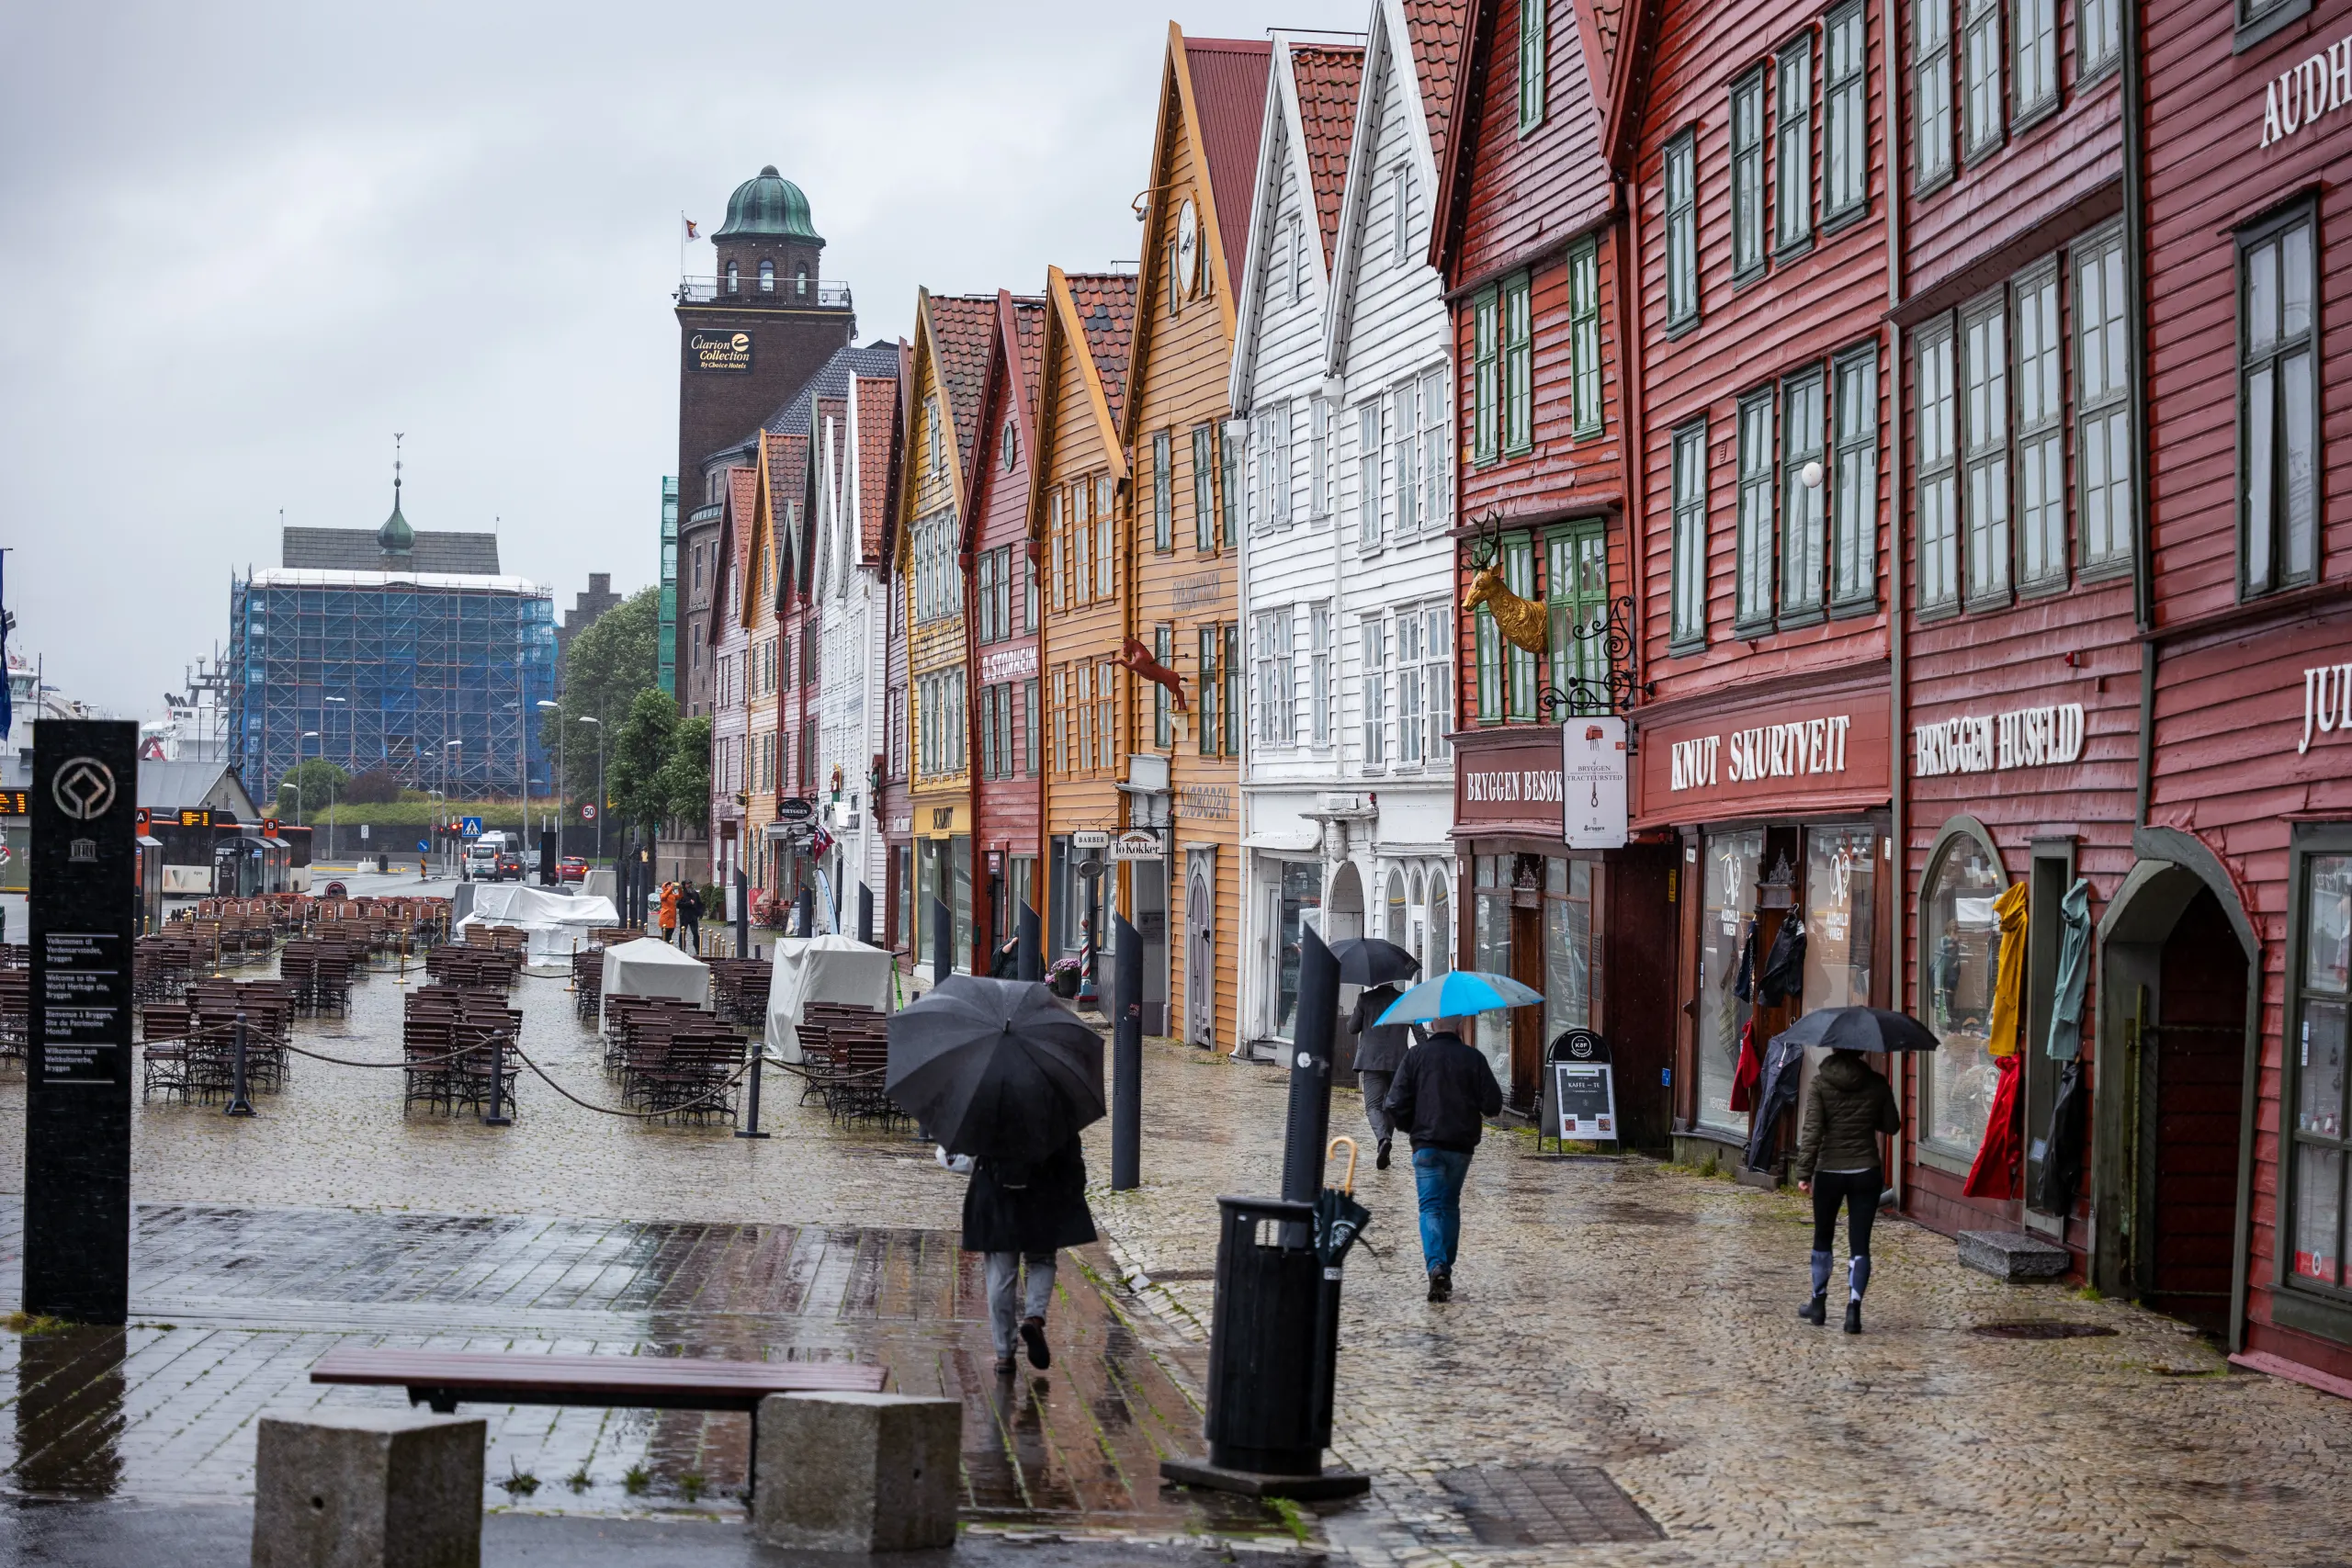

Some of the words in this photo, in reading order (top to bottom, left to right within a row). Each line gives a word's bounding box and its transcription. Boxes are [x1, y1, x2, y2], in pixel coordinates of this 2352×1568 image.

[2260, 35, 2352, 149] AUDH
[691, 334, 730, 350] Clarion
[699, 350, 750, 361] Collection
[991, 646, 1037, 680] STORHEIM
[1916, 716, 1995, 777] BRYGGEN
[1997, 703, 2085, 770] HUSFLID
[1670, 735, 1721, 791] KNUT
[1728, 715, 1850, 783] SKURTVEIT
[1466, 772, 1521, 802] BRYGGEN
[1180, 786, 1230, 818] SJØBODEN
[136, 812, 145, 821] A
[584, 807, 594, 817] 50
[268, 821, 274, 829] B
[1114, 842, 1125, 854] To
[1125, 842, 1160, 854] Kokker
[1721, 908, 1739, 923] AUDHILD
[1826, 911, 1849, 927] AUDHILD
[1723, 922, 1736, 936] VIKEN
[1828, 927, 1844, 942] VIKEN
[46, 937, 84, 945] Velkommen
[46, 954, 73, 963] Bryggen
[67, 983, 95, 992] Heritage
[46, 991, 73, 999] Bryggen
[44, 1065, 71, 1073] Bryggen
